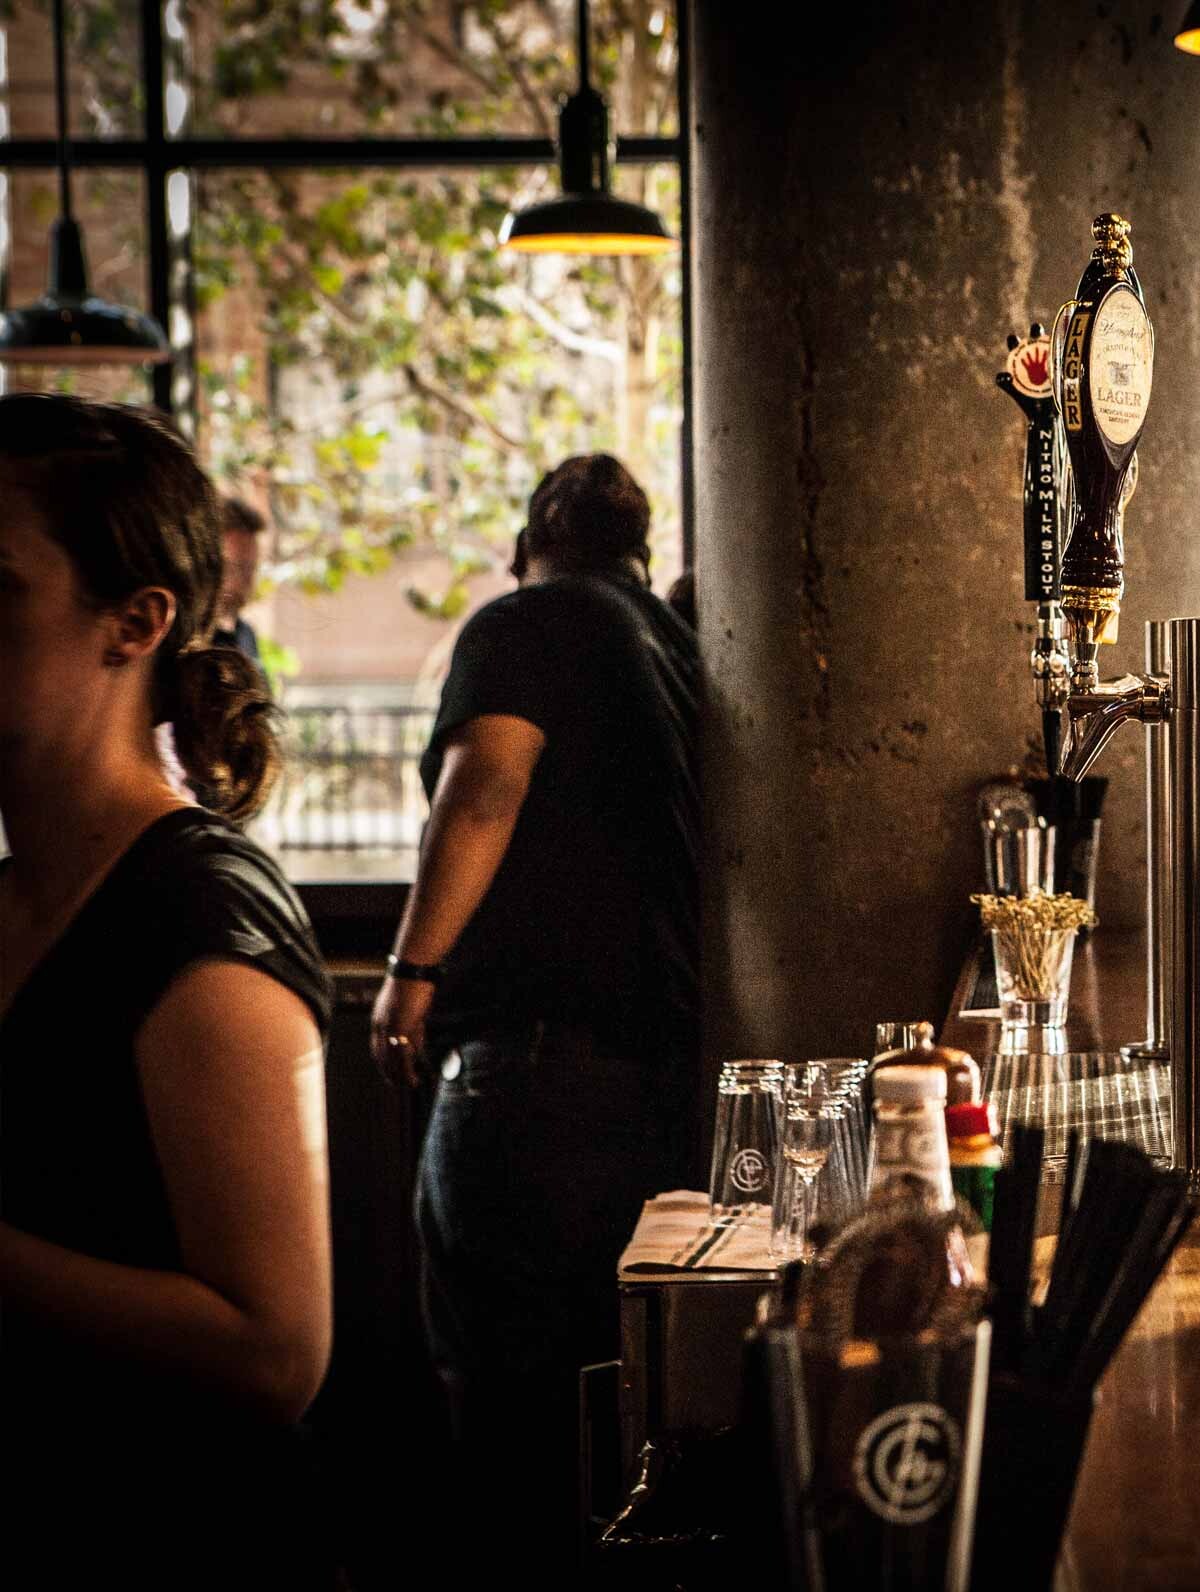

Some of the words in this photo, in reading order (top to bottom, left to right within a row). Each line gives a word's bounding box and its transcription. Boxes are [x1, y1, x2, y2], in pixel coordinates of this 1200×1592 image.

[1066, 318, 1083, 425] LAGER
[1097, 387, 1142, 407] LAGER
[1039, 430, 1052, 483] NITRO
[1039, 490, 1054, 534] MILK
[1041, 540, 1054, 595] STOUT
